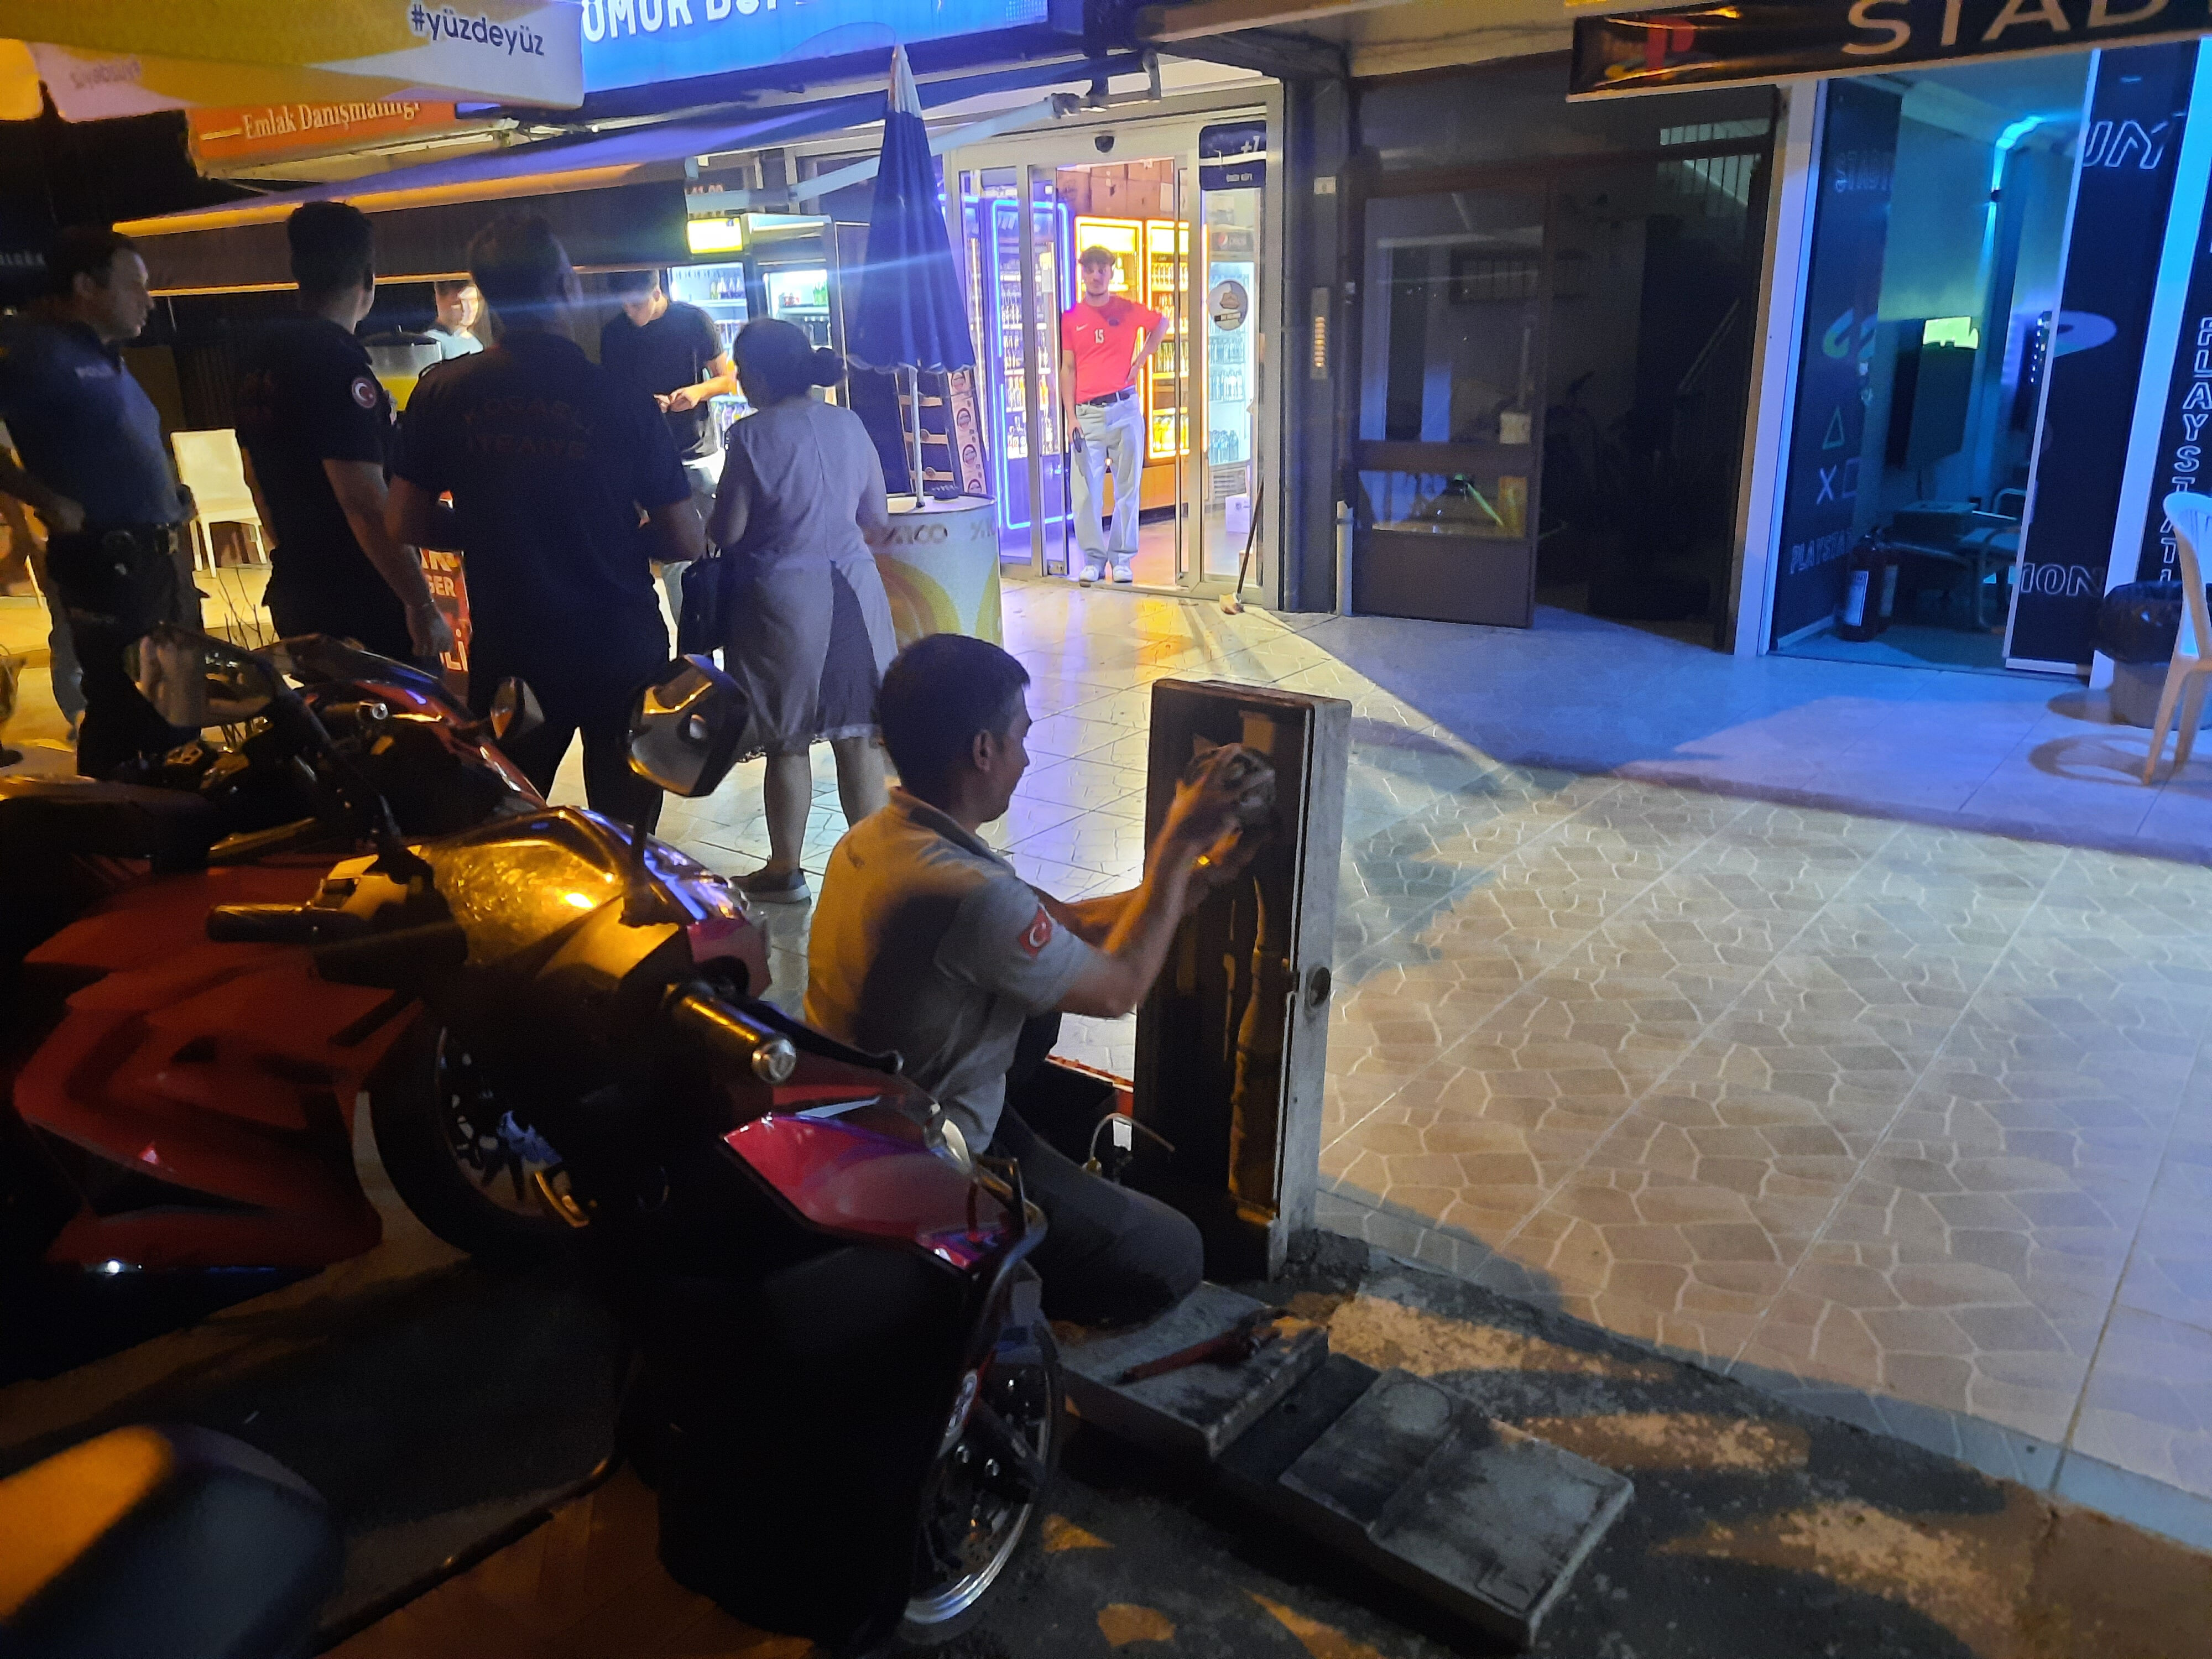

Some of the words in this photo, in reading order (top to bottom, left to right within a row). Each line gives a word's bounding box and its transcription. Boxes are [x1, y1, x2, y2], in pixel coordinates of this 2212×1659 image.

[411, 4, 545, 56] #yüzdeyüz
[1841, 0, 2212, 55] STAD
[243, 106, 296, 139] Emlak
[1094, 328, 1104, 344] 15
